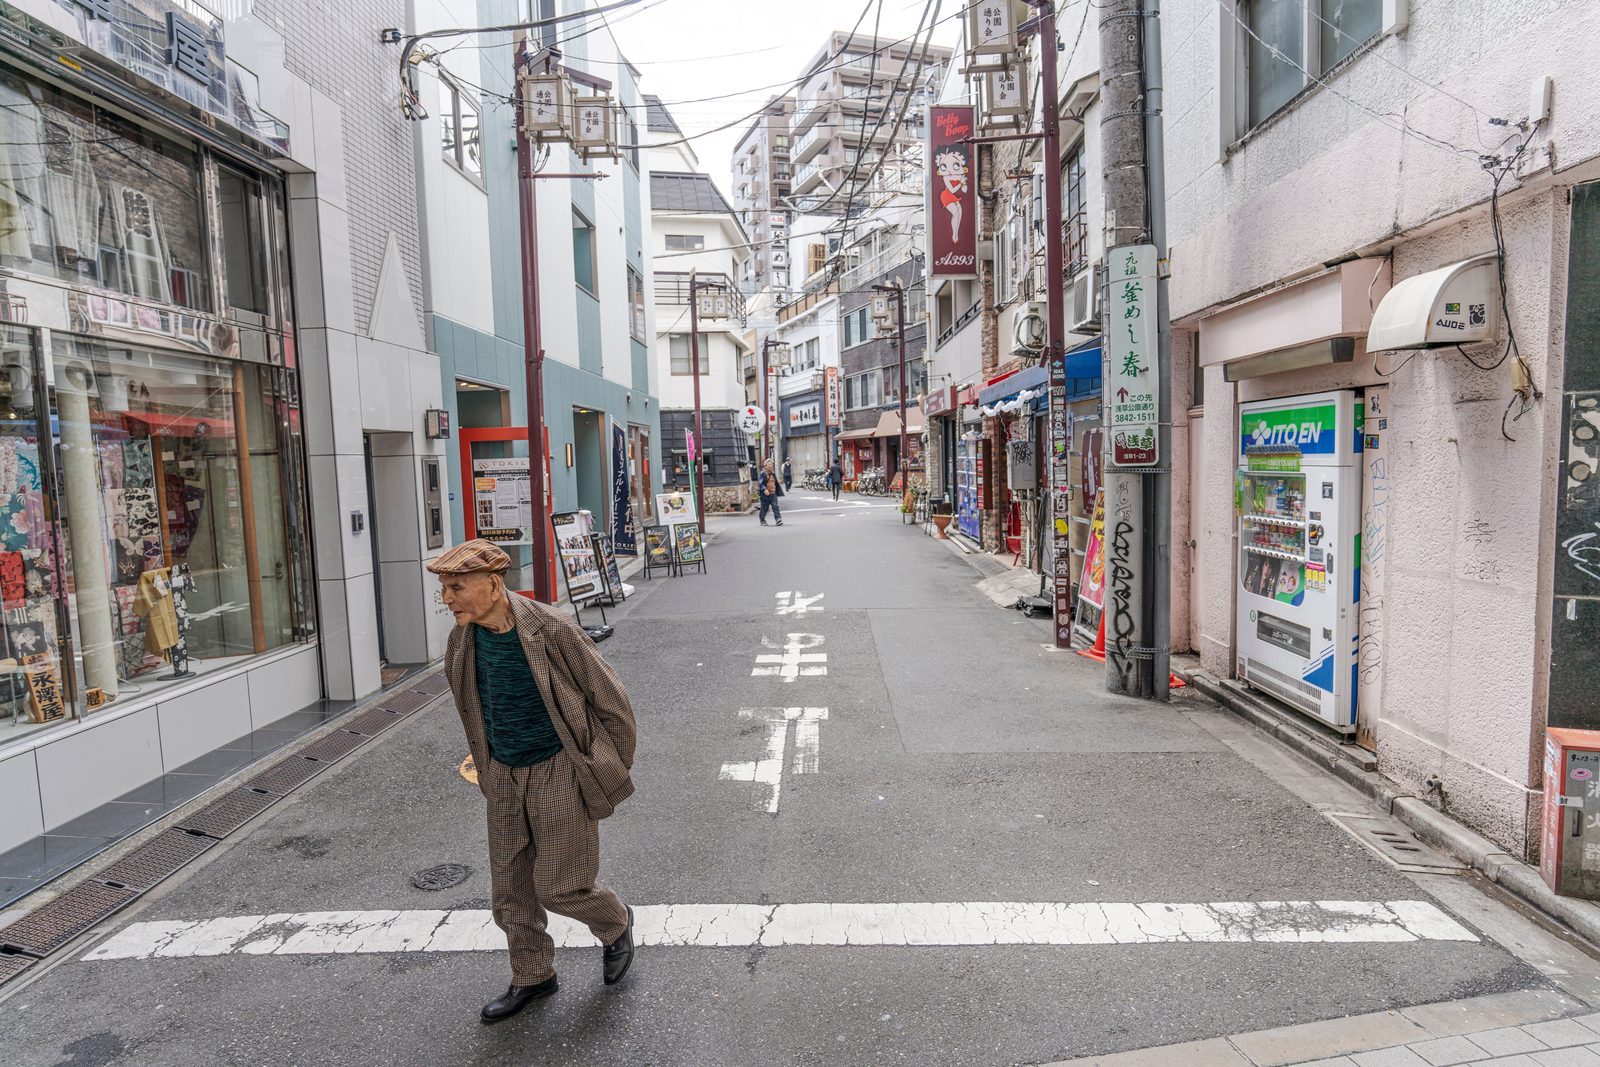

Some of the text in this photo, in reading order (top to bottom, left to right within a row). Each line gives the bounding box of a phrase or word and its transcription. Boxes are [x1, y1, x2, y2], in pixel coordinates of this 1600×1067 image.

[983, 7, 993, 37] 通り会
[992, 7, 1002, 27] 公園
[536, 90, 544, 116] 通り会
[544, 89, 552, 107] 公園
[592, 110, 600, 126] 公園
[936, 112, 960, 128] Betty
[945, 123, 970, 138] Boop
[935, 251, 974, 266] A393
[1124, 251, 1138, 276] 元祖
[1120, 282, 1144, 378] 釜めし春
[1130, 394, 1153, 402] この先
[1115, 403, 1155, 412] 浅草公園通り
[1115, 413, 1155, 422] 3842-1511
[1270, 421, 1322, 445] ITO EN
[1127, 434, 1153, 450] 浅草
